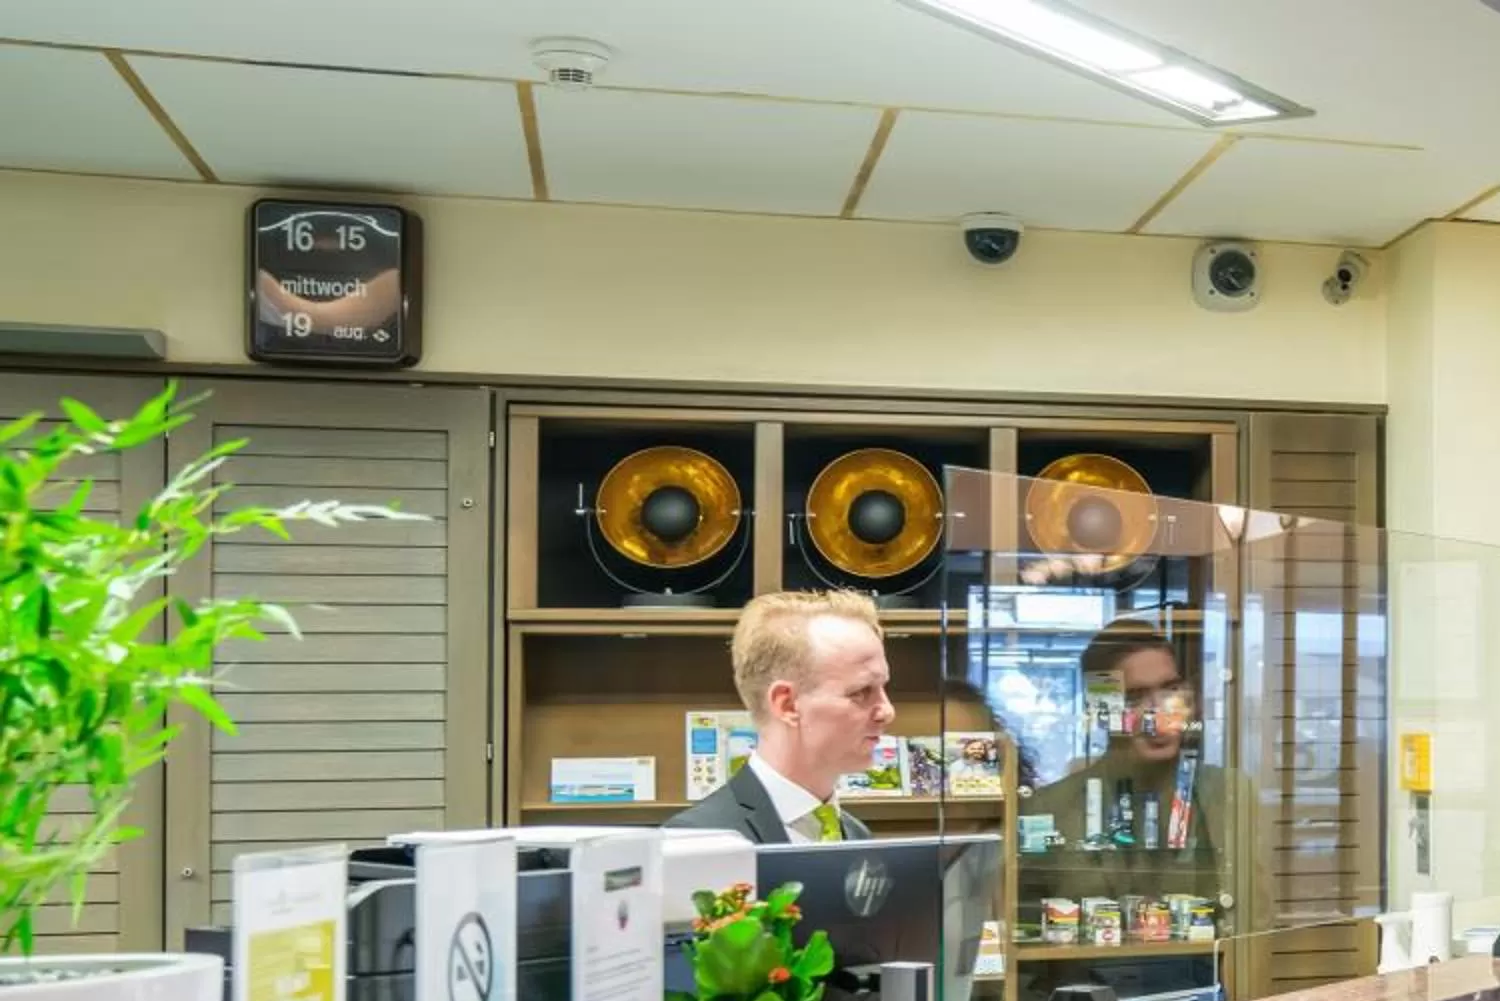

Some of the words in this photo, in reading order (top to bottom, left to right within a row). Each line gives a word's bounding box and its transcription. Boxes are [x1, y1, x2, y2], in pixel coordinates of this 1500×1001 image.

[281, 221, 314, 251] 16
[336, 225, 367, 251] 15
[280, 276, 368, 298] mittwoch
[282, 312, 313, 337] 19
